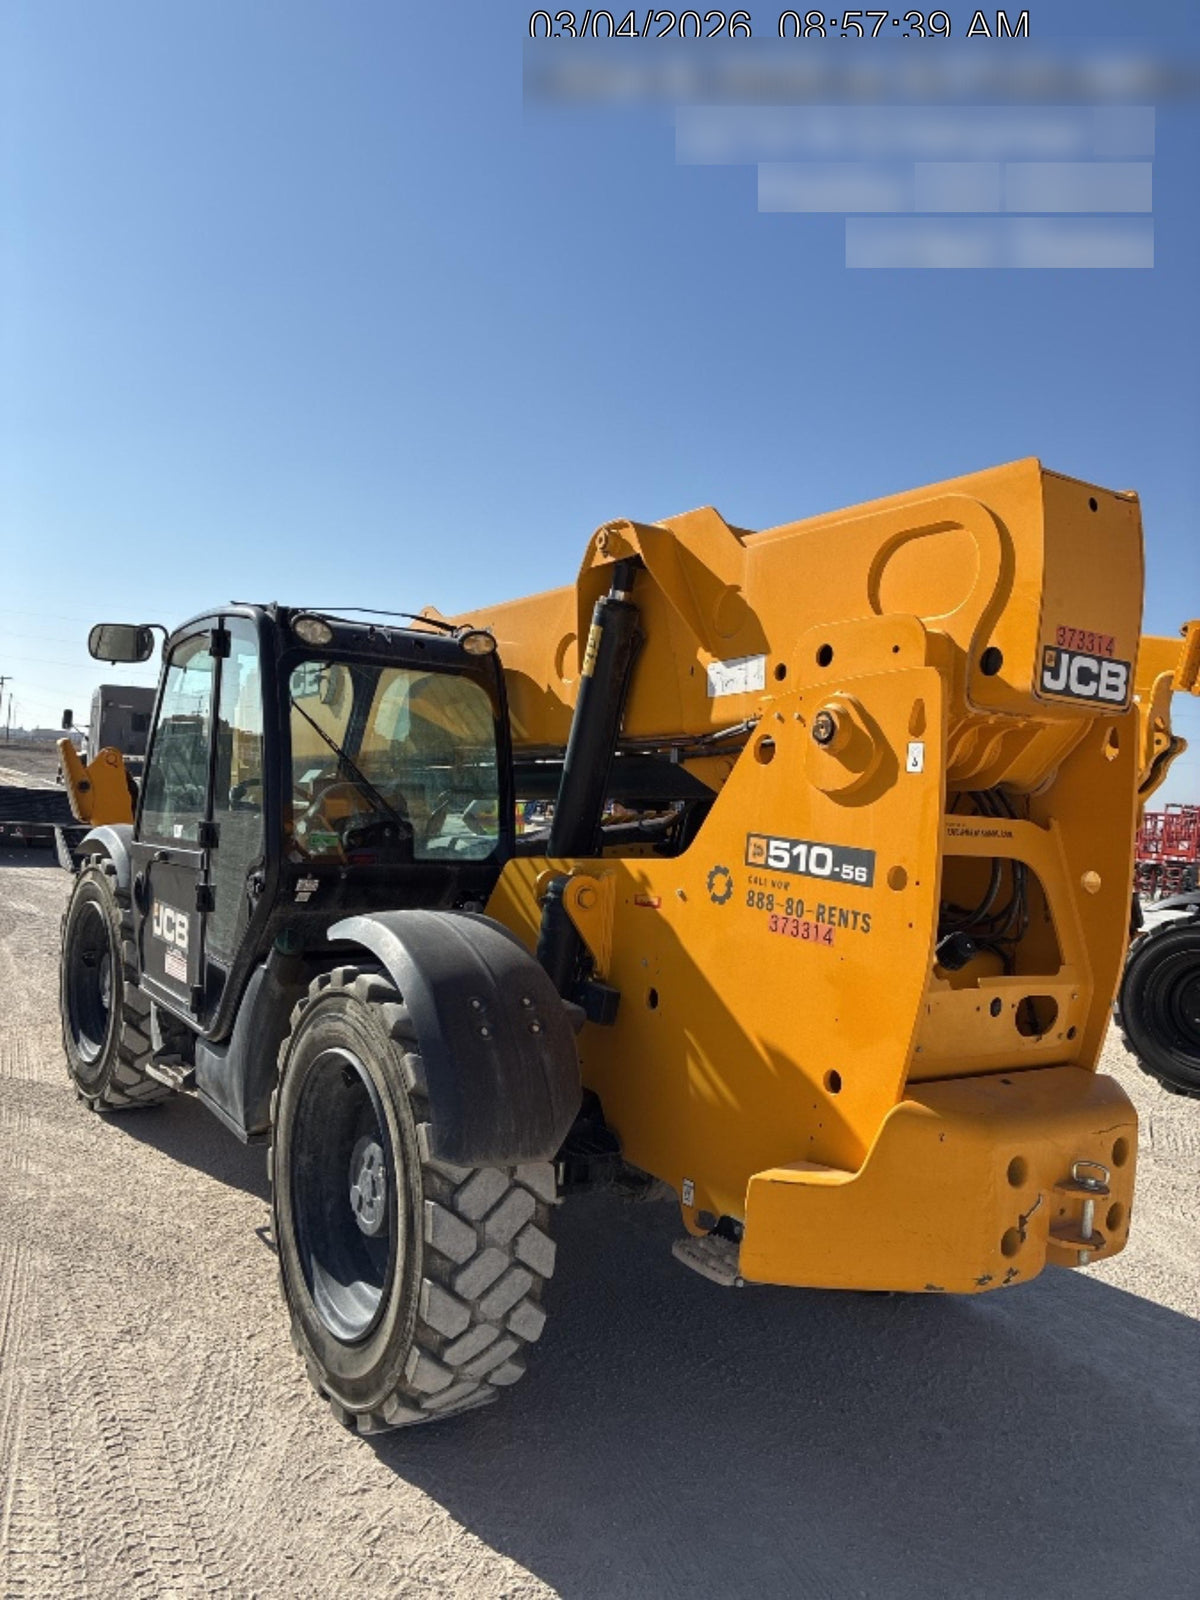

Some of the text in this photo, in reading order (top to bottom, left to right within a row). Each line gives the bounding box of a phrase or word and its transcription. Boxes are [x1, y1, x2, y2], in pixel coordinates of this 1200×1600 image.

[1057, 626, 1116, 657] 373314
[1043, 652, 1127, 701] JCB
[771, 880, 790, 891] NOW
[153, 902, 188, 949] JCB
[746, 889, 872, 934] 888-80-RENTS
[769, 914, 834, 945] 373314
